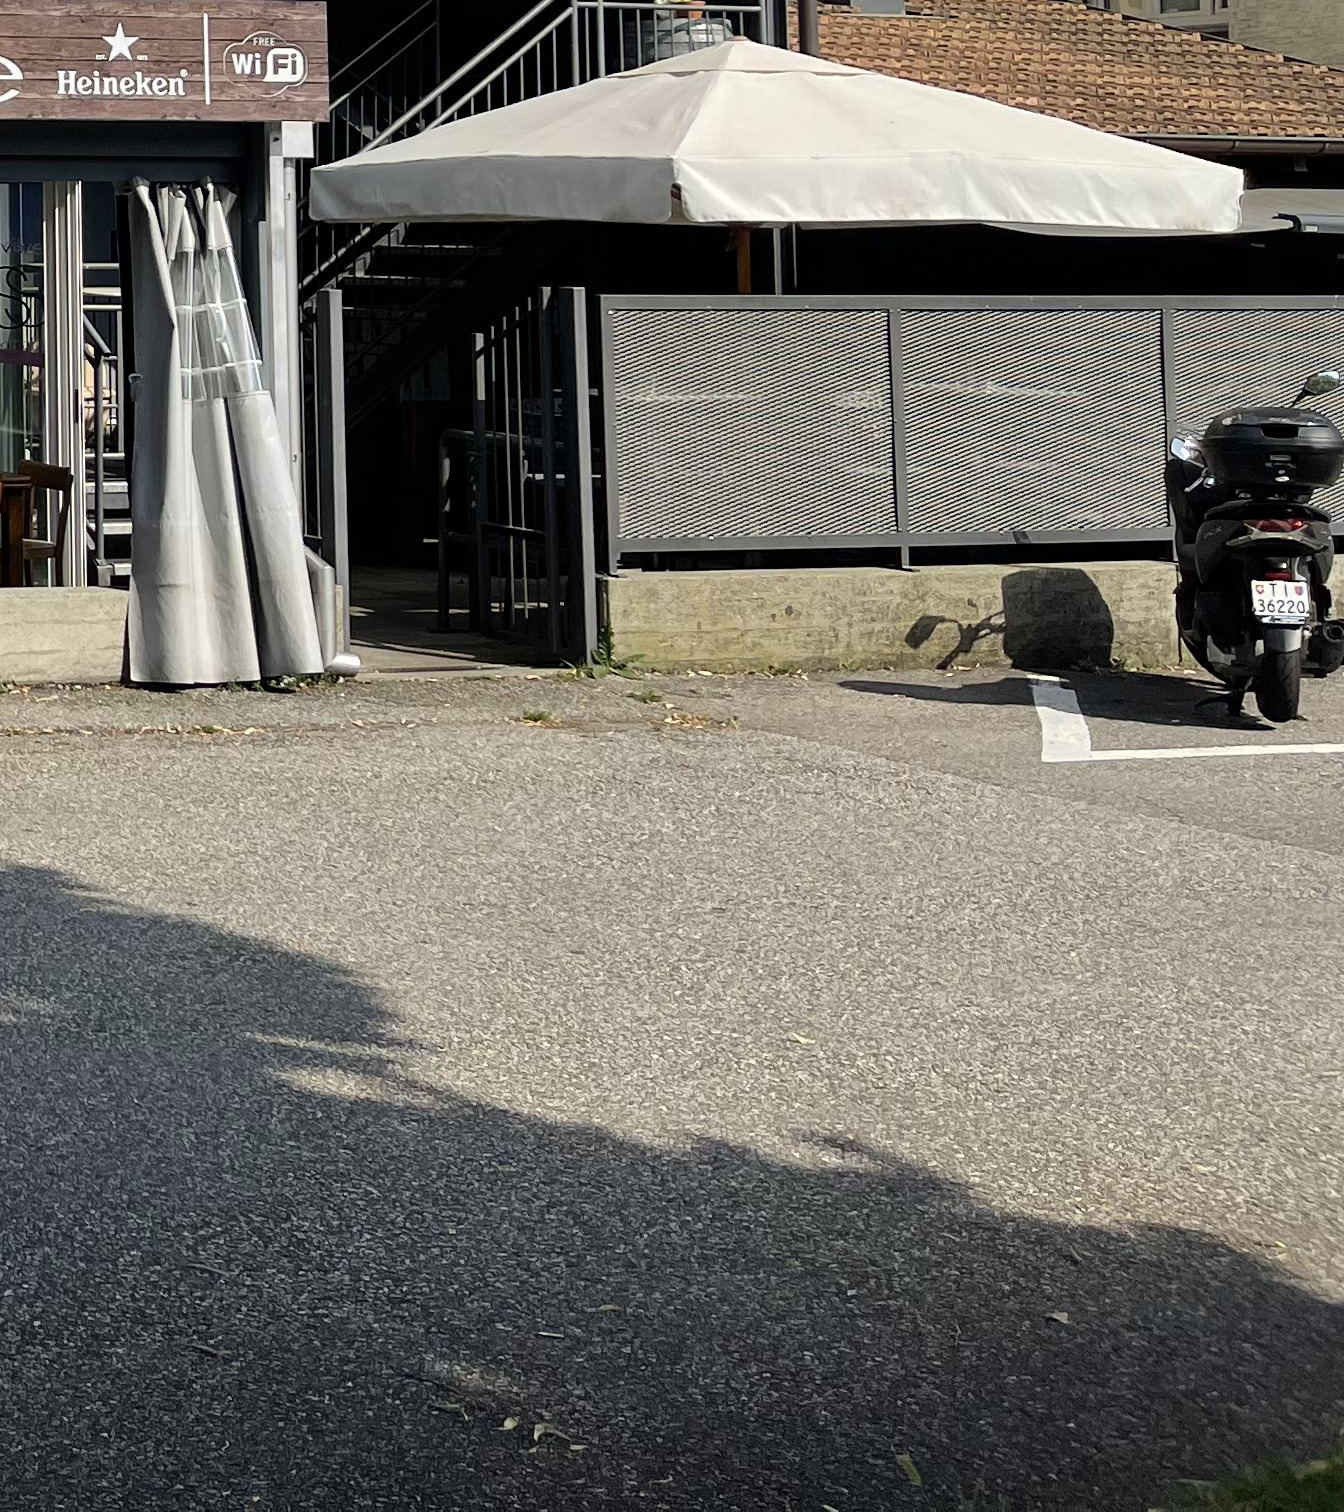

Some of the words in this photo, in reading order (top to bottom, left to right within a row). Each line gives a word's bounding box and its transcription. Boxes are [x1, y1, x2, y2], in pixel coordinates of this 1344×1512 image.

[252, 37, 276, 47] FREE
[56, 69, 186, 97] Heineken
[1257, 599, 1305, 614] 36220
